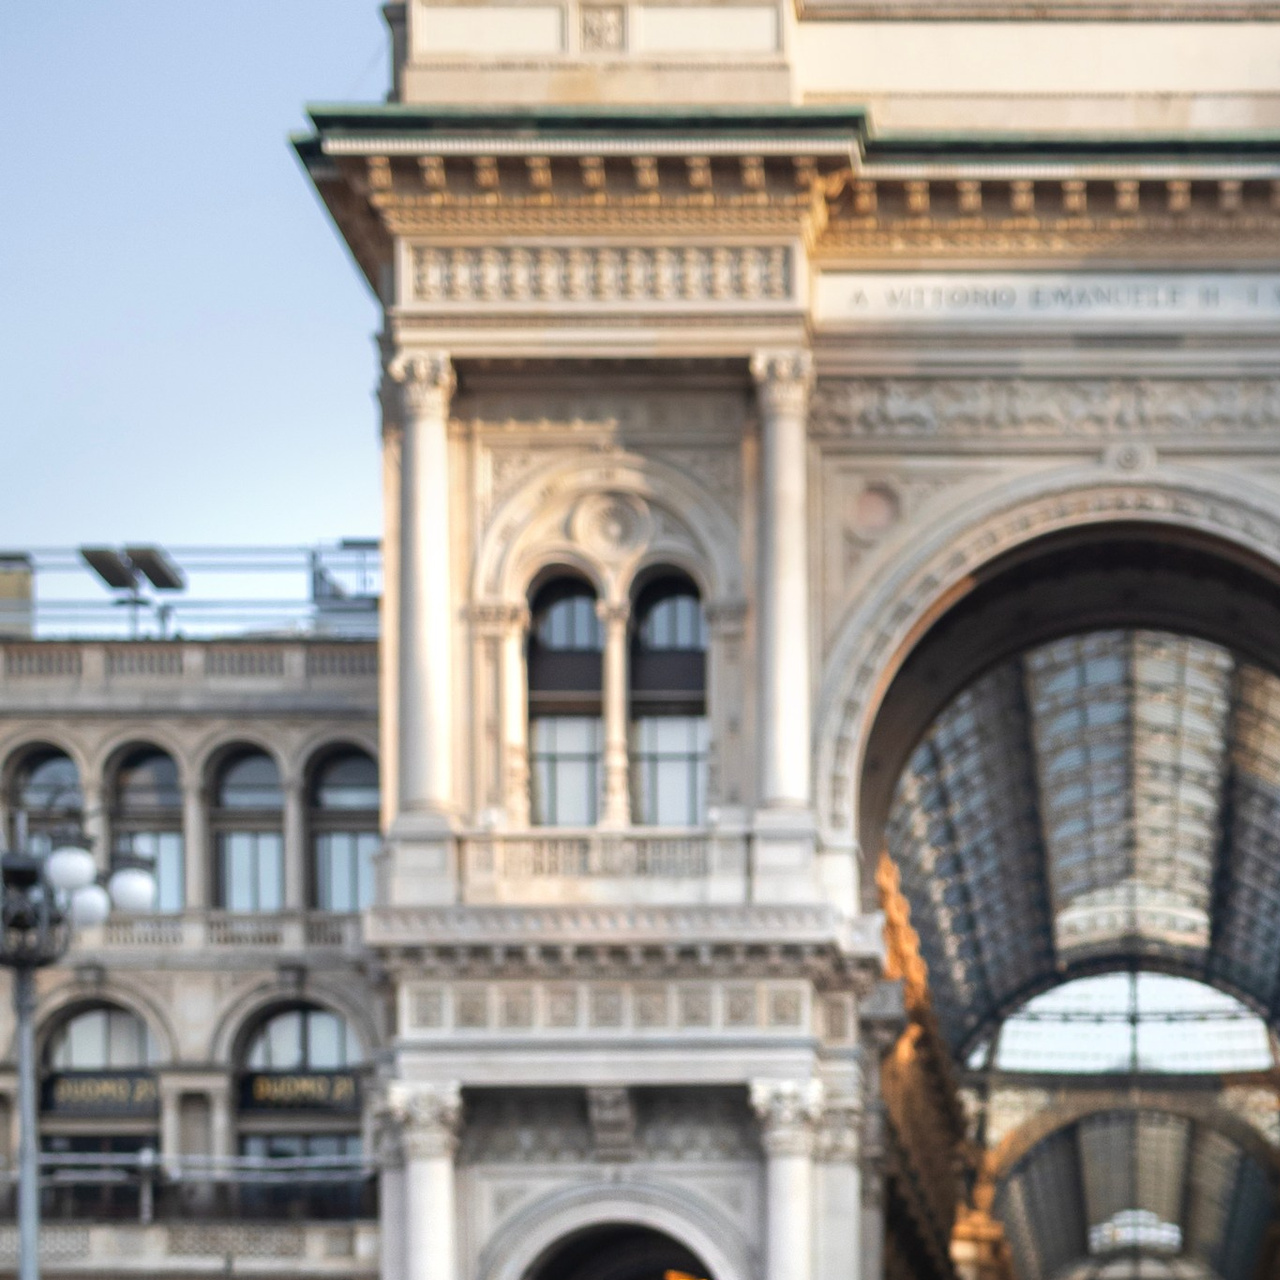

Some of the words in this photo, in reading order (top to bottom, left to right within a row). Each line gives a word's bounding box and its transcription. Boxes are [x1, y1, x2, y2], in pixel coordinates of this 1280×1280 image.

[847, 284, 869, 309] A
[883, 284, 1017, 309] VITTORIO
[1029, 284, 1180, 309] EMANUELE
